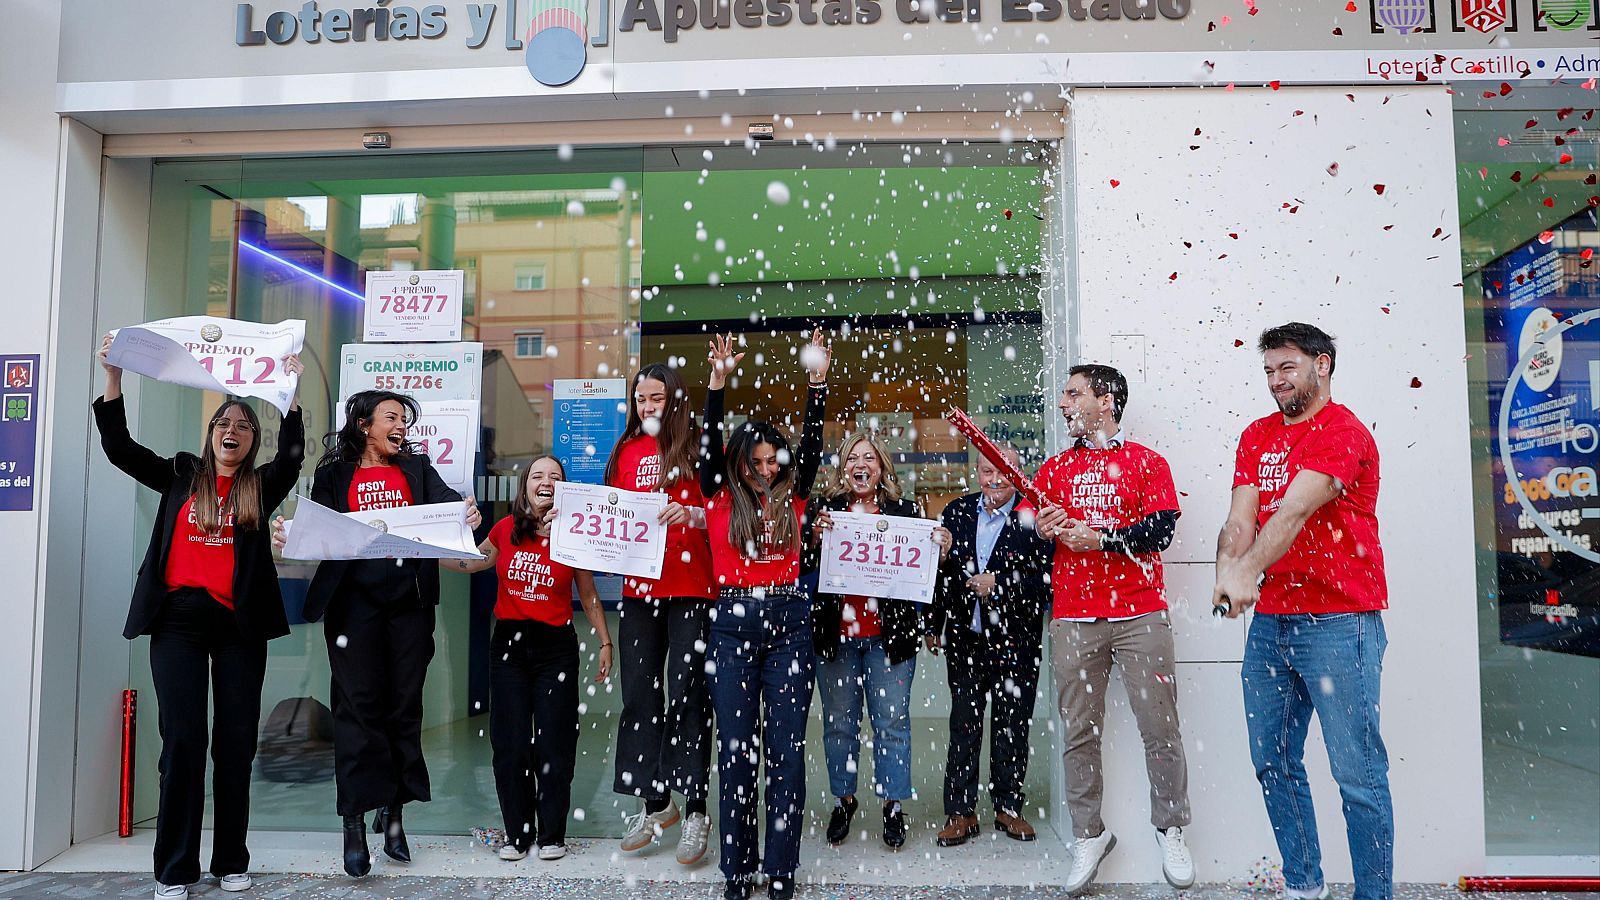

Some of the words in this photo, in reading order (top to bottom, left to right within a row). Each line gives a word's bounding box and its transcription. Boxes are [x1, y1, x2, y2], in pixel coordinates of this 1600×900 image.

[235, 0, 447, 46] Loterías
[466, 3, 497, 49] y
[619, 0, 882, 43] Apuestas
[1367, 57, 1442, 75] Lotería
[1450, 56, 1530, 75] Castillo
[379, 295, 448, 313] 78477
[363, 361, 403, 372] GRAN
[405, 360, 459, 372] PREMIO
[374, 375, 443, 389] 55.726€
[14, 475, 31, 488] del
[1073, 472, 1102, 485] #SOY
[357, 480, 386, 492] #SOY
[1072, 484, 1116, 497] LOTERIA
[357, 490, 403, 504] LOTERIA
[1072, 496, 1121, 509] CASTILLO
[569, 512, 649, 543] 23112
[514, 550, 541, 563] #SOY
[838, 540, 921, 568] 23112
[509, 559, 551, 575] LOTERIA
[507, 569, 555, 587] CASTILLO
